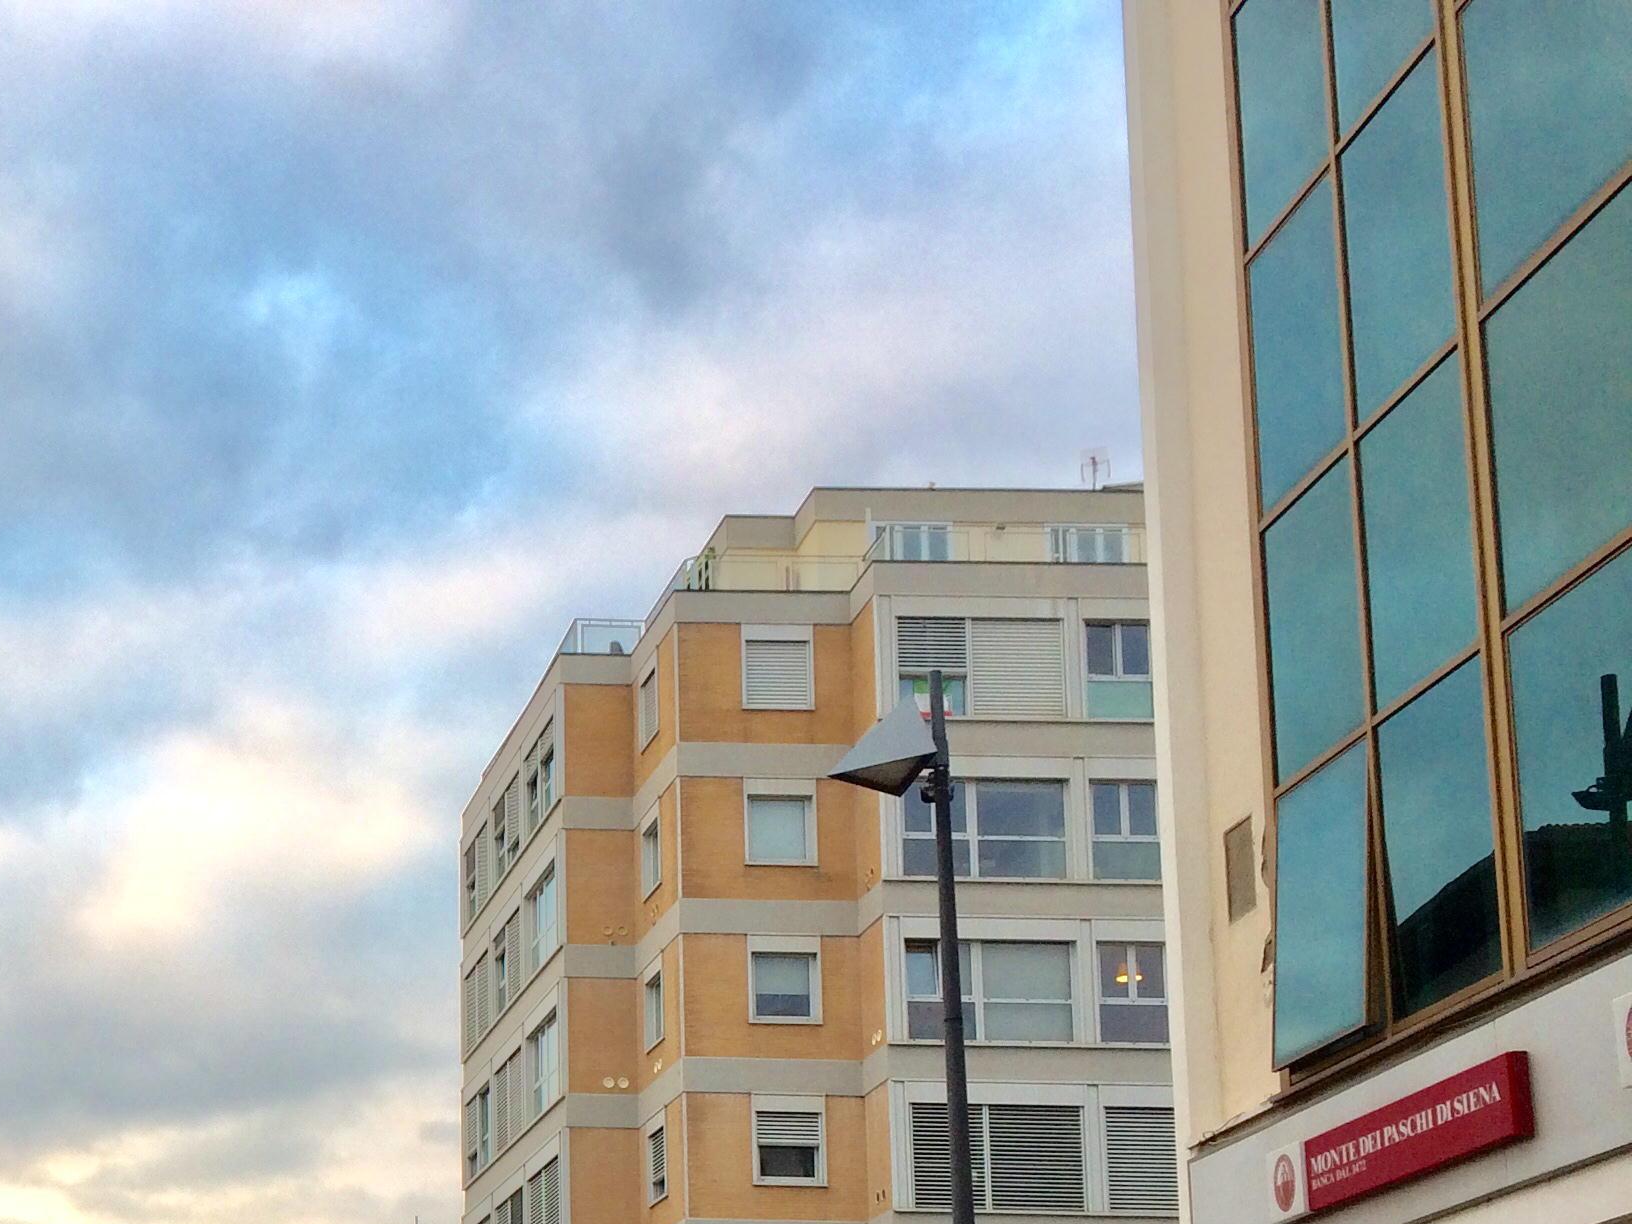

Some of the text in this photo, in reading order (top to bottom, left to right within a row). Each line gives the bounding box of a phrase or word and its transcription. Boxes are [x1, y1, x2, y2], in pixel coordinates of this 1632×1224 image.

[1311, 1080, 1502, 1177] MONTE DEI PASCHI DI SIENA
[1311, 1171, 1334, 1190] BANCA
[1335, 1166, 1350, 1181] DAL
